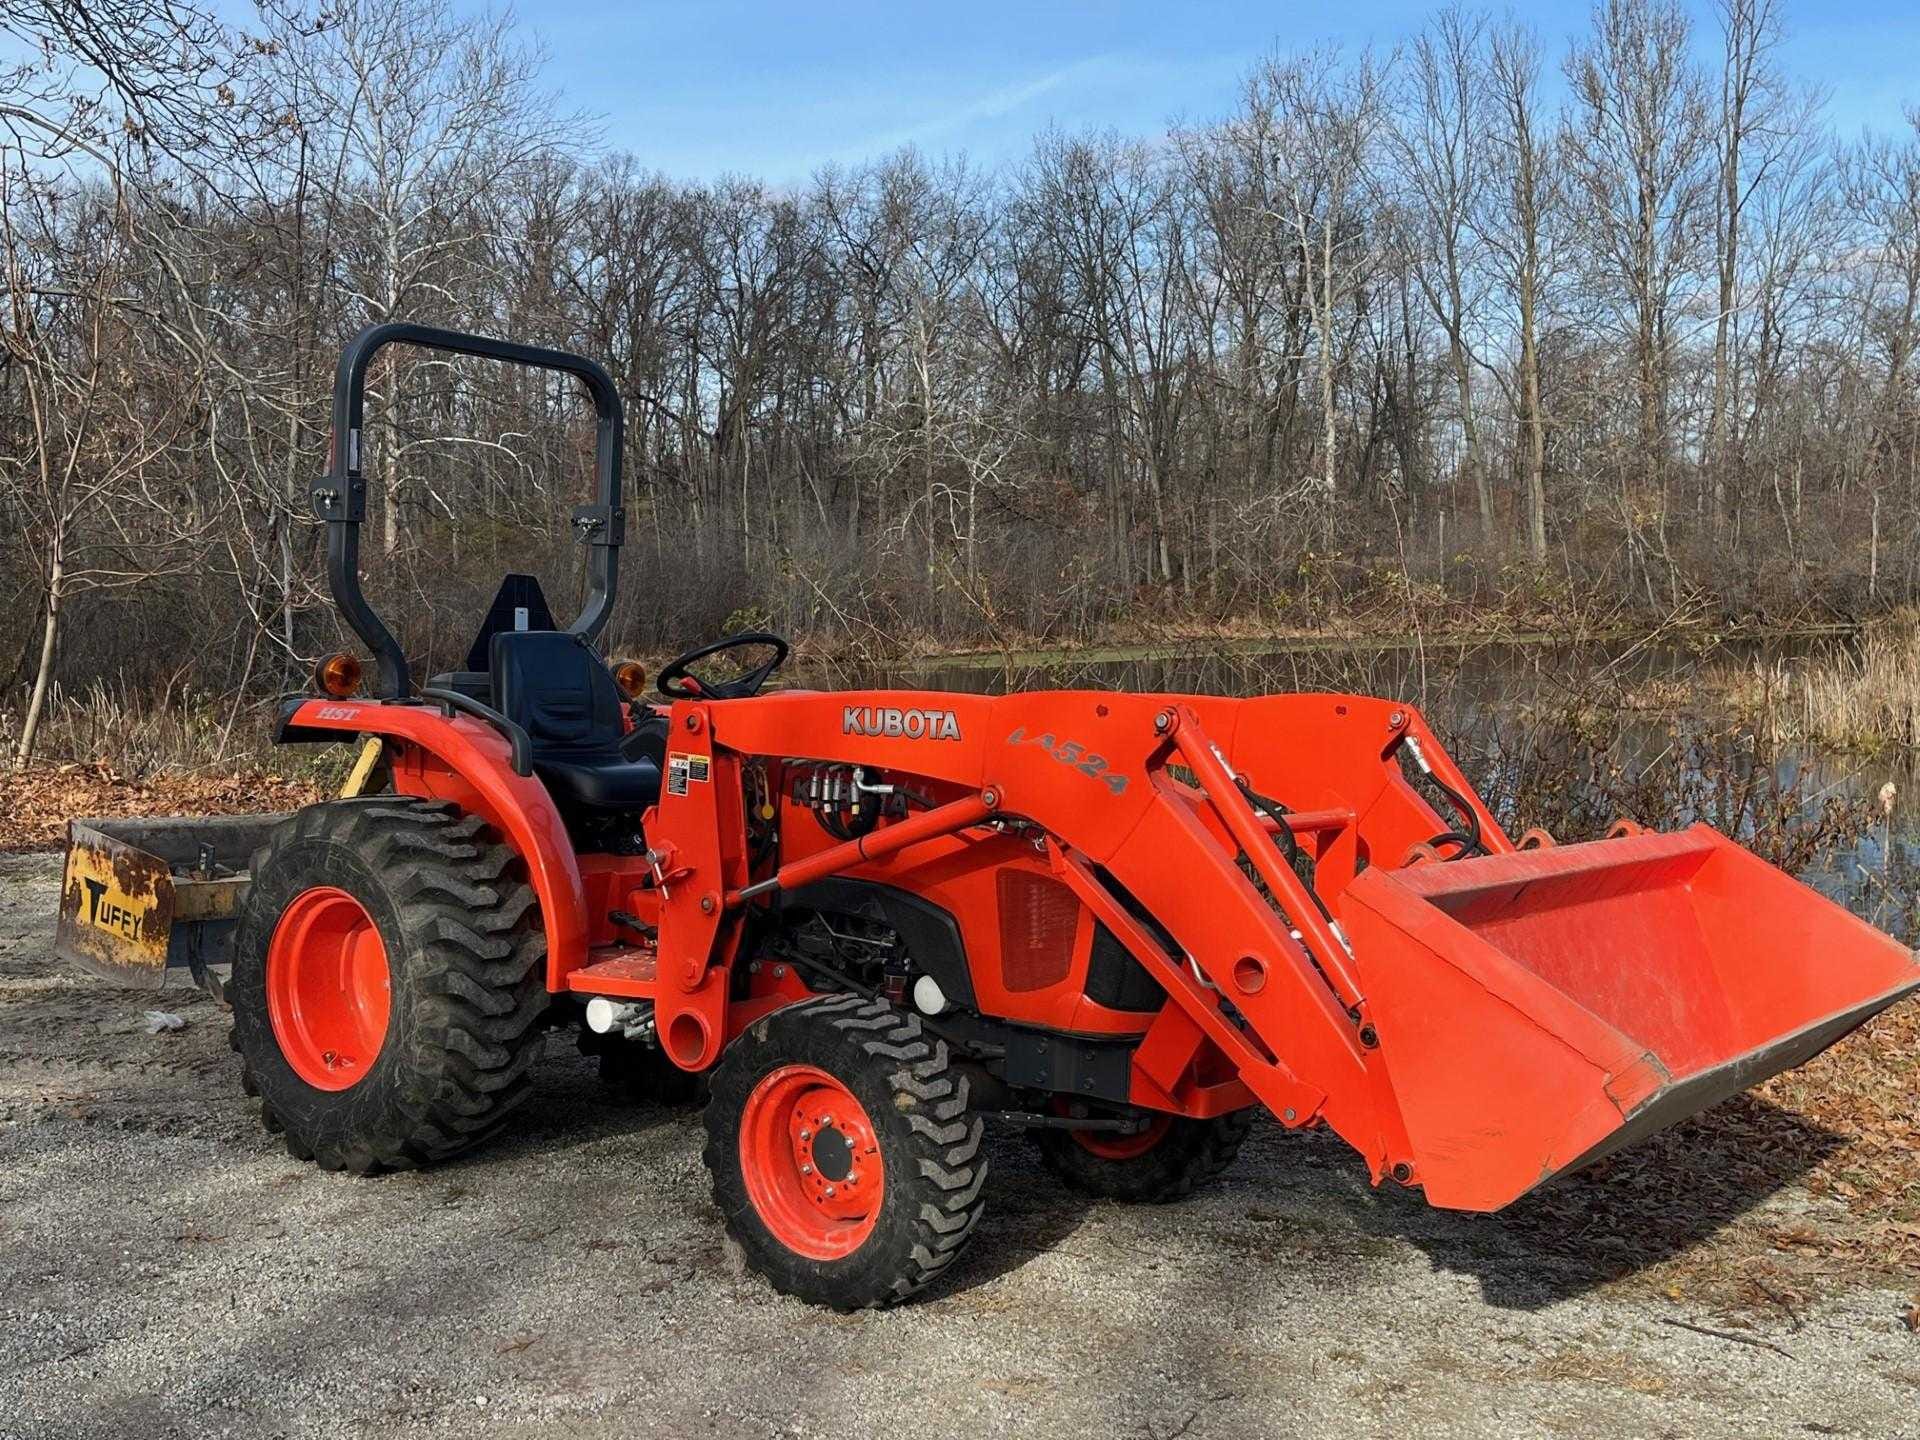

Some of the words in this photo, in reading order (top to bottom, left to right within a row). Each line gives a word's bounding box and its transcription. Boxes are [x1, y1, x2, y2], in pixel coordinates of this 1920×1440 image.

[315, 707, 361, 720] HST
[843, 706, 961, 741] KUBOTA
[1007, 726, 1128, 795] LA524
[84, 876, 141, 942] TUFFY
